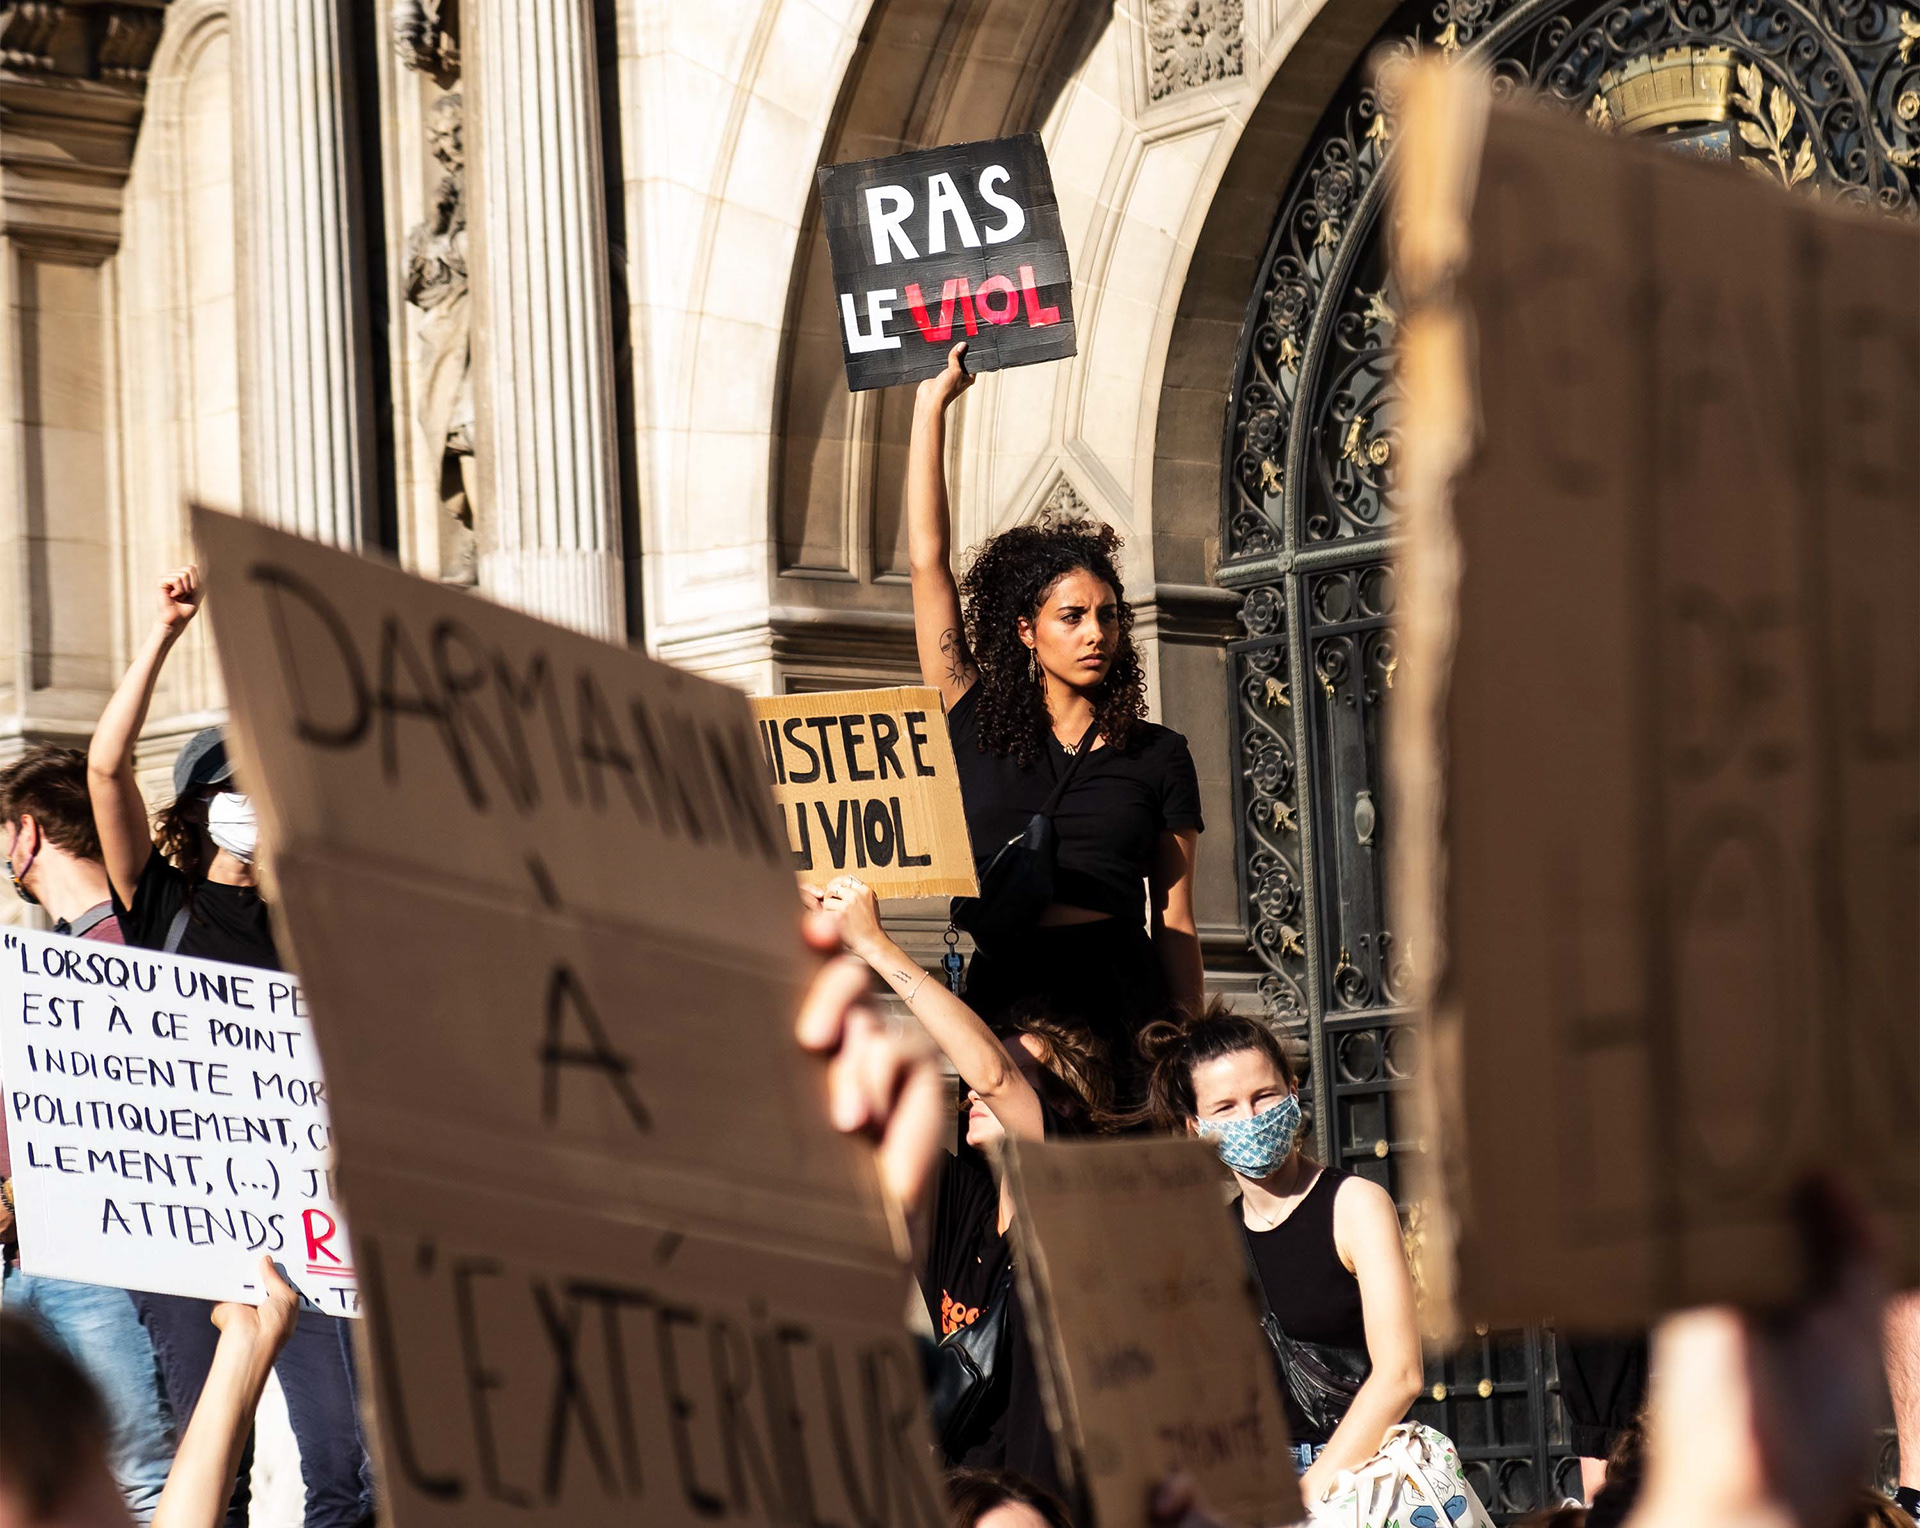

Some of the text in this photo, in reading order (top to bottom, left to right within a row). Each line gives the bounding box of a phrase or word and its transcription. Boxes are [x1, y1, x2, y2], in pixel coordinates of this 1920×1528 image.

[865, 164, 1026, 265] RAS
[840, 265, 1061, 354] LE VIOL
[814, 796, 932, 869] VIOL
[23, 992, 302, 1058] EST À CE POINT
[27, 1044, 234, 1098] INDIGENTE
[12, 1090, 334, 1154] POLITIQUEMENT, C
[27, 1140, 214, 1196] LEMENT,
[226, 1156, 281, 1201] (...)
[101, 1197, 285, 1252] ATTENDS
